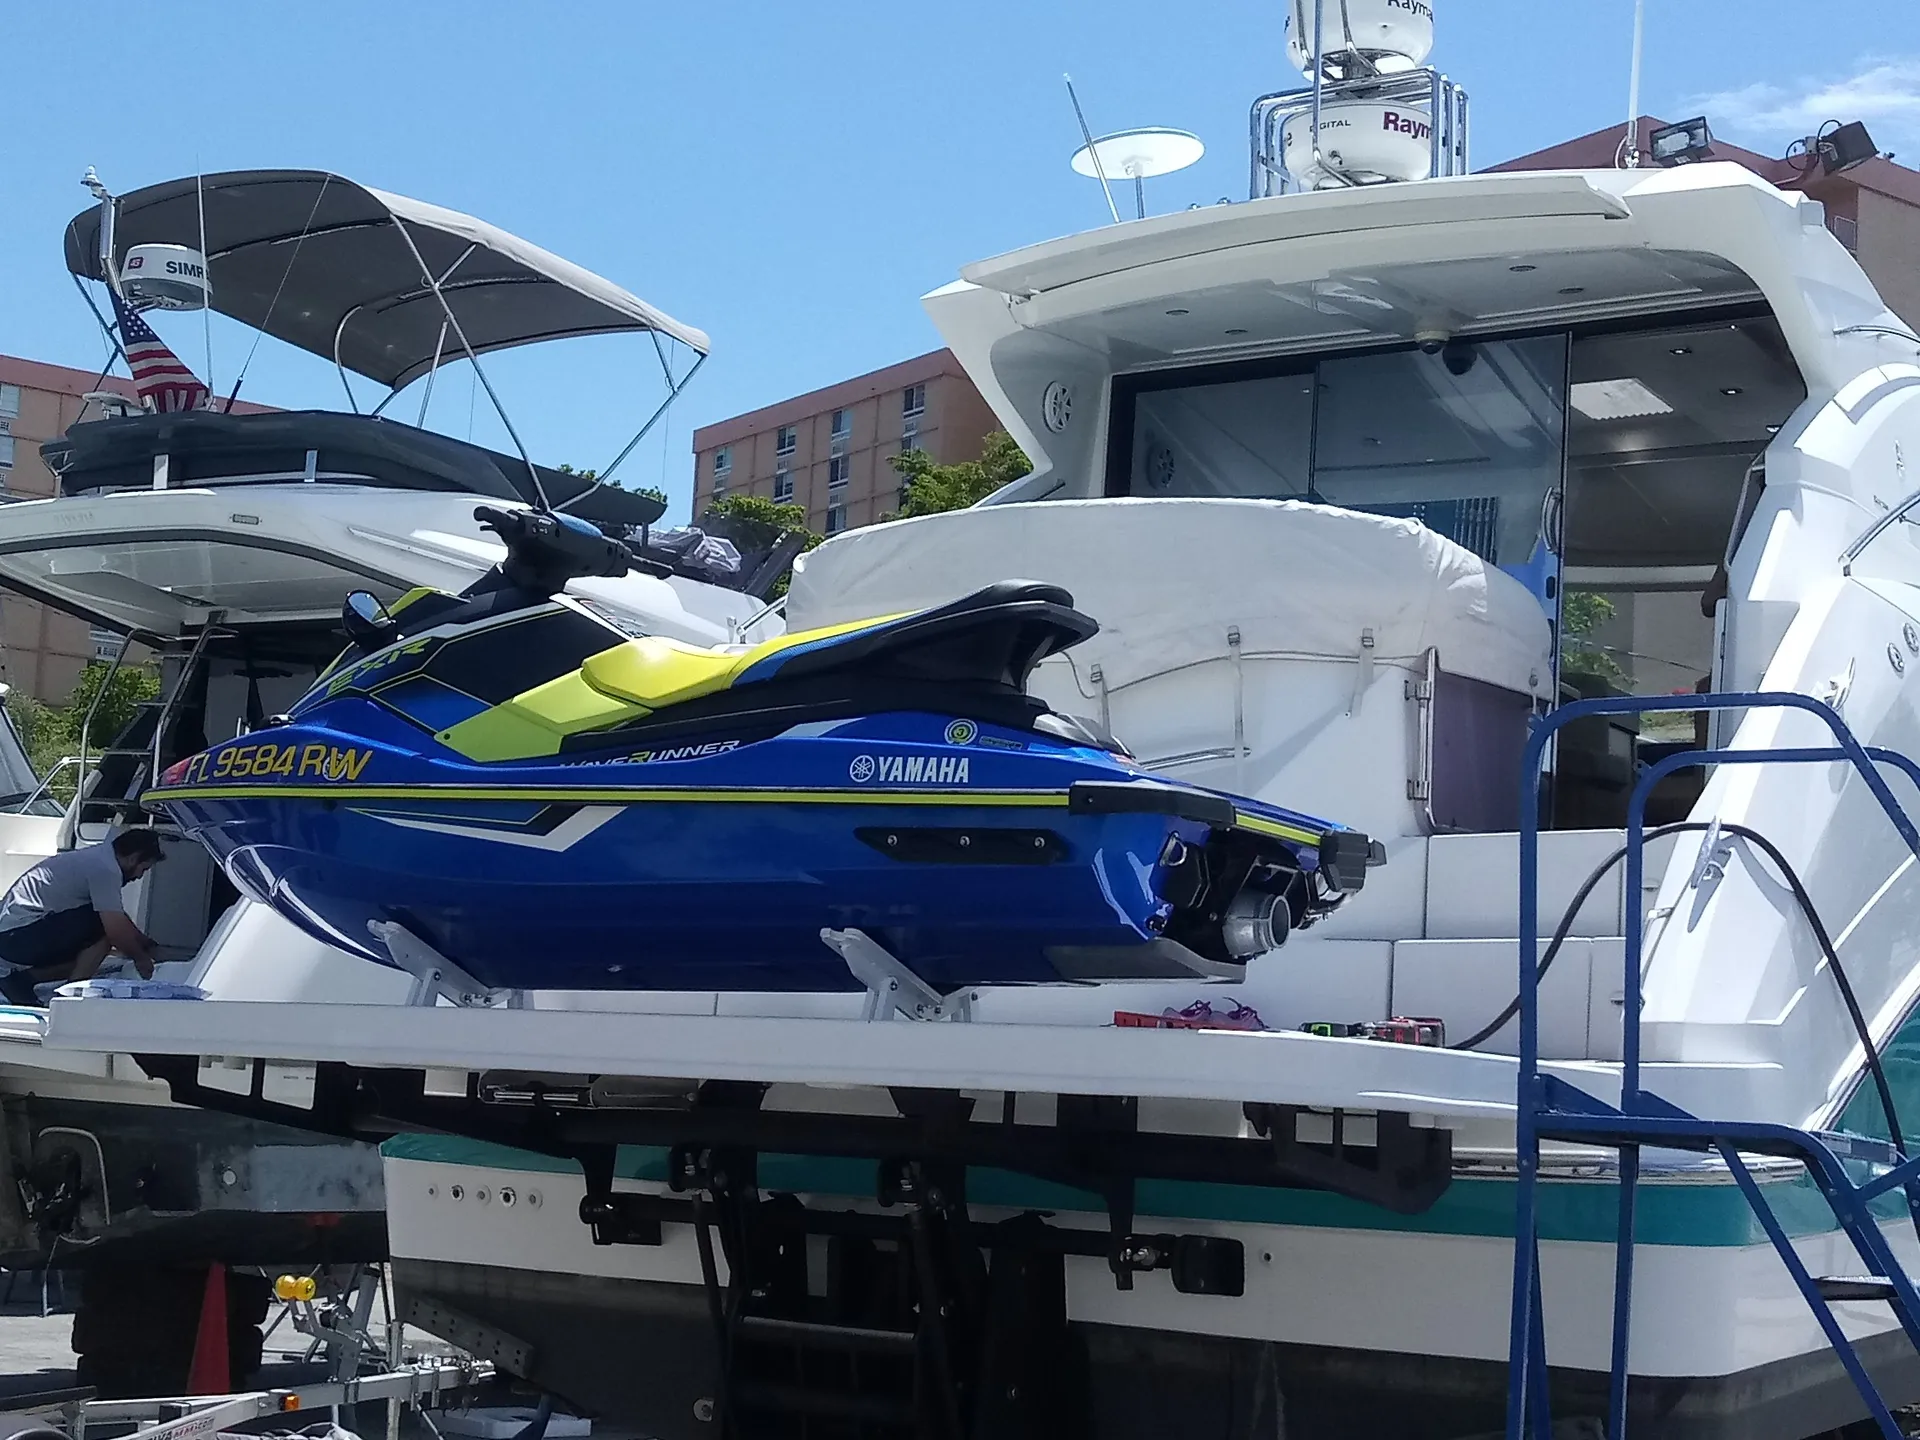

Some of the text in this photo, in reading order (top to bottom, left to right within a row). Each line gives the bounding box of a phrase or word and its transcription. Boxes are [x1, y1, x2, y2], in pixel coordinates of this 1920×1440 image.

[1309, 119, 1351, 132] DGITAL
[184, 752, 210, 783] FL
[213, 745, 297, 778] 9584
[299, 745, 373, 781] RW
[878, 757, 970, 783] YAMAHA
